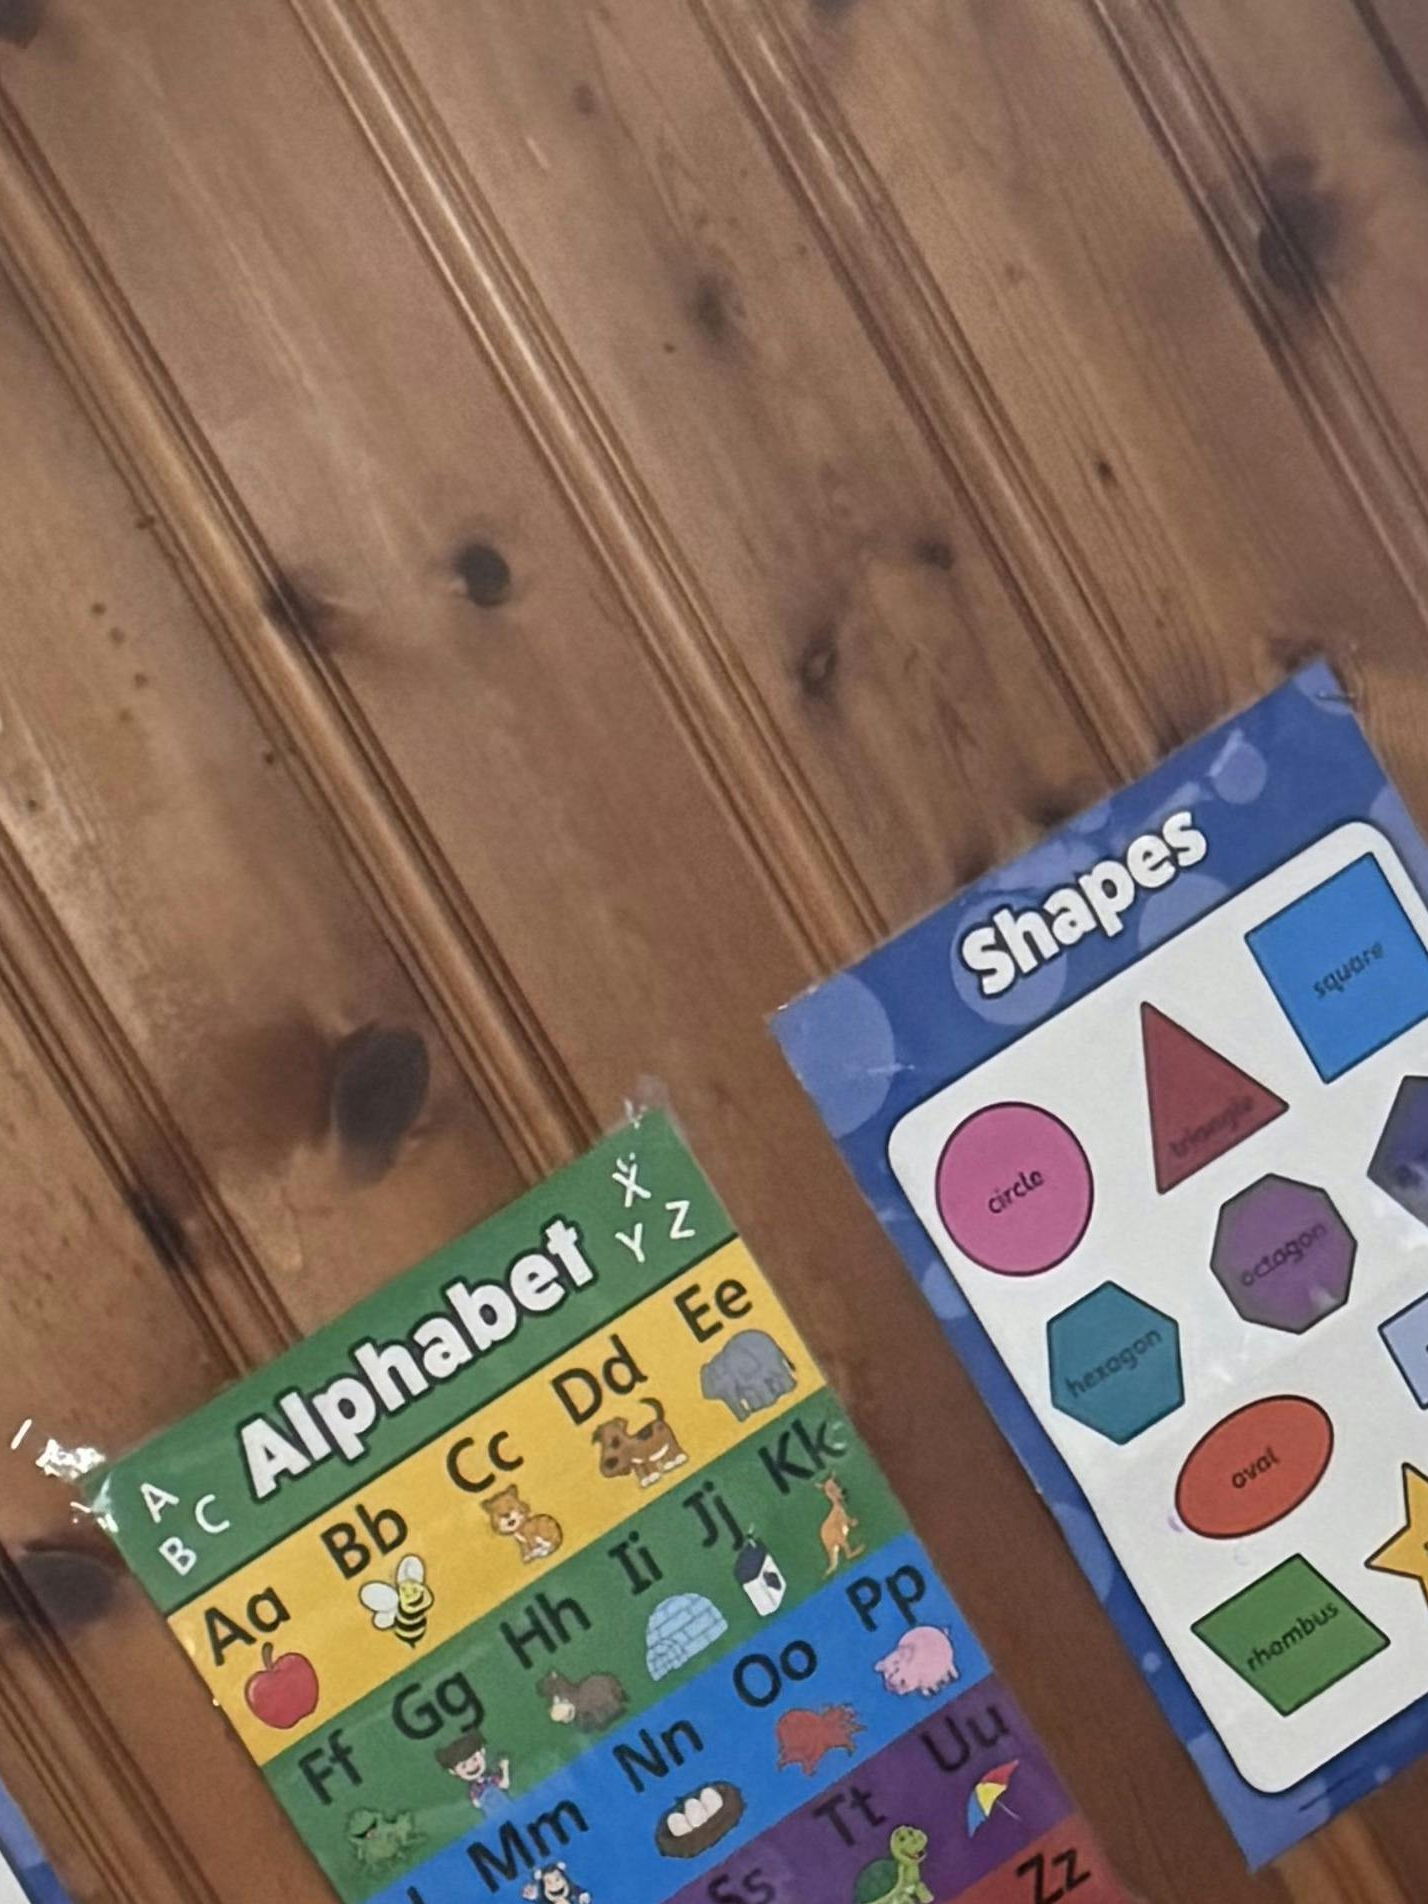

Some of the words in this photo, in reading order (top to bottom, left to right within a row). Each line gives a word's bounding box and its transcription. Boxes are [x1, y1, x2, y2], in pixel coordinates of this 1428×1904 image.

[961, 811, 1208, 996] Shapes
[1313, 941, 1383, 999] square
[612, 1162, 651, 1208] X
[988, 1168, 1044, 1215] circle
[615, 1223, 645, 1263] Y
[665, 1200, 695, 1240] Z
[1241, 1223, 1328, 1287] octagon
[239, 1219, 596, 1499] Alphabet
[1064, 1329, 1162, 1399] hexagon
[139, 1482, 179, 1523] A
[202, 1586, 291, 1668] Aa
[321, 1502, 409, 1580] Bb
[446, 1430, 524, 1494] Cc
[550, 1333, 648, 1426] Dd
[674, 1276, 753, 1343] Ee
[1232, 1448, 1280, 1489] oval
[159, 1536, 197, 1576] B
[194, 1494, 230, 1534] C
[298, 1728, 364, 1806] Ff
[392, 1672, 485, 1740] Gg
[500, 1593, 593, 1670] Hh
[608, 1530, 664, 1596] Ii
[682, 1481, 748, 1551] Jj
[757, 1418, 844, 1496] Kk
[1247, 1602, 1339, 1672] rhombus
[466, 1799, 589, 1894] Mm
[613, 1717, 705, 1794] Nn
[733, 1640, 818, 1708] Oo
[845, 1564, 927, 1632] Pp
[813, 1786, 887, 1849] Tt
[920, 1704, 1011, 1774] Uu
